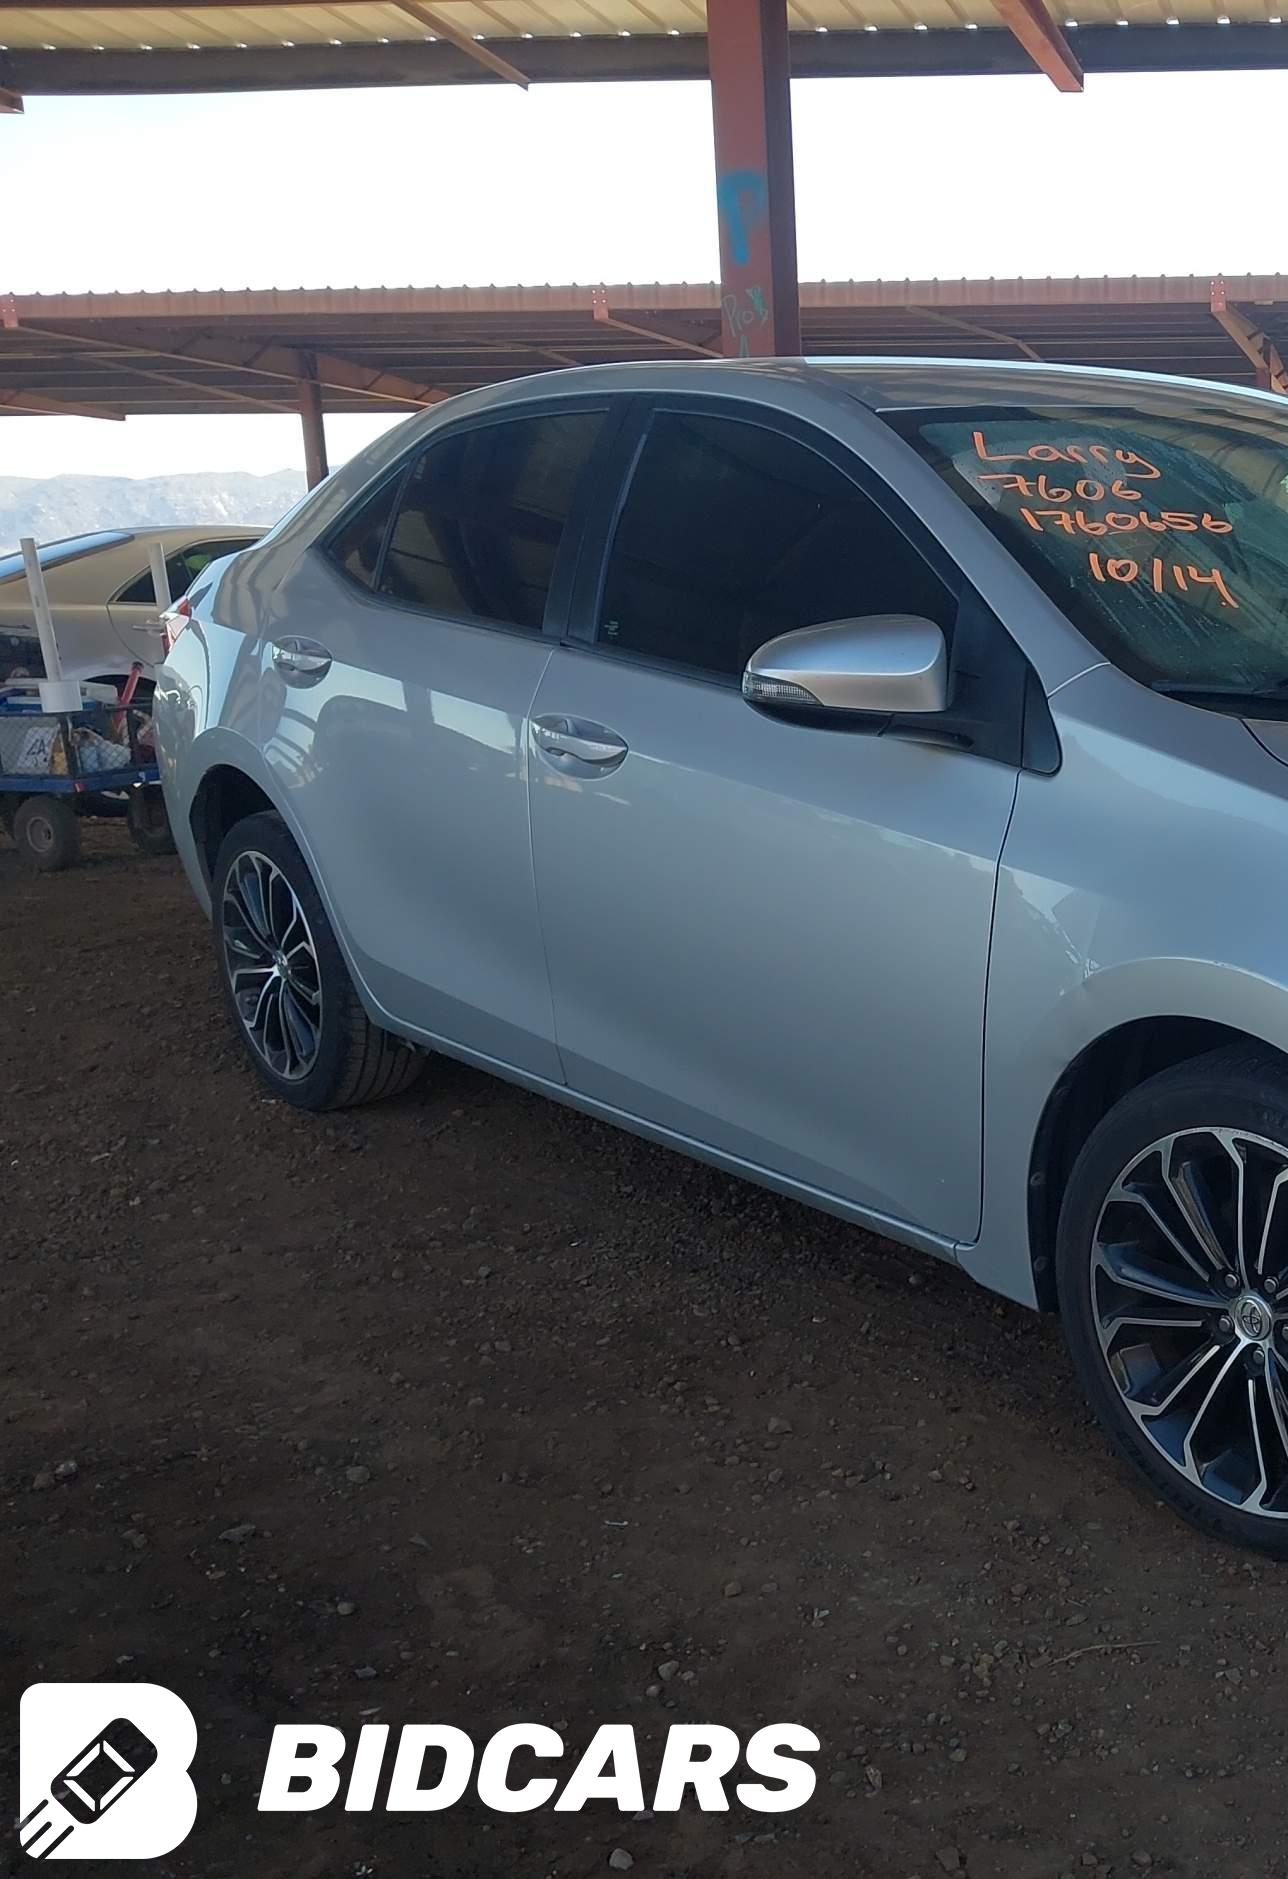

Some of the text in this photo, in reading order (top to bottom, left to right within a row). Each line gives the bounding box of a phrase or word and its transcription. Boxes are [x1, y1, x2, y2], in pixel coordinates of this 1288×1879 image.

[972, 431, 1161, 479] Larry
[977, 473, 1142, 503] 7606
[1019, 507, 1233, 536] 1760656
[1088, 552, 1240, 608] 10/14
